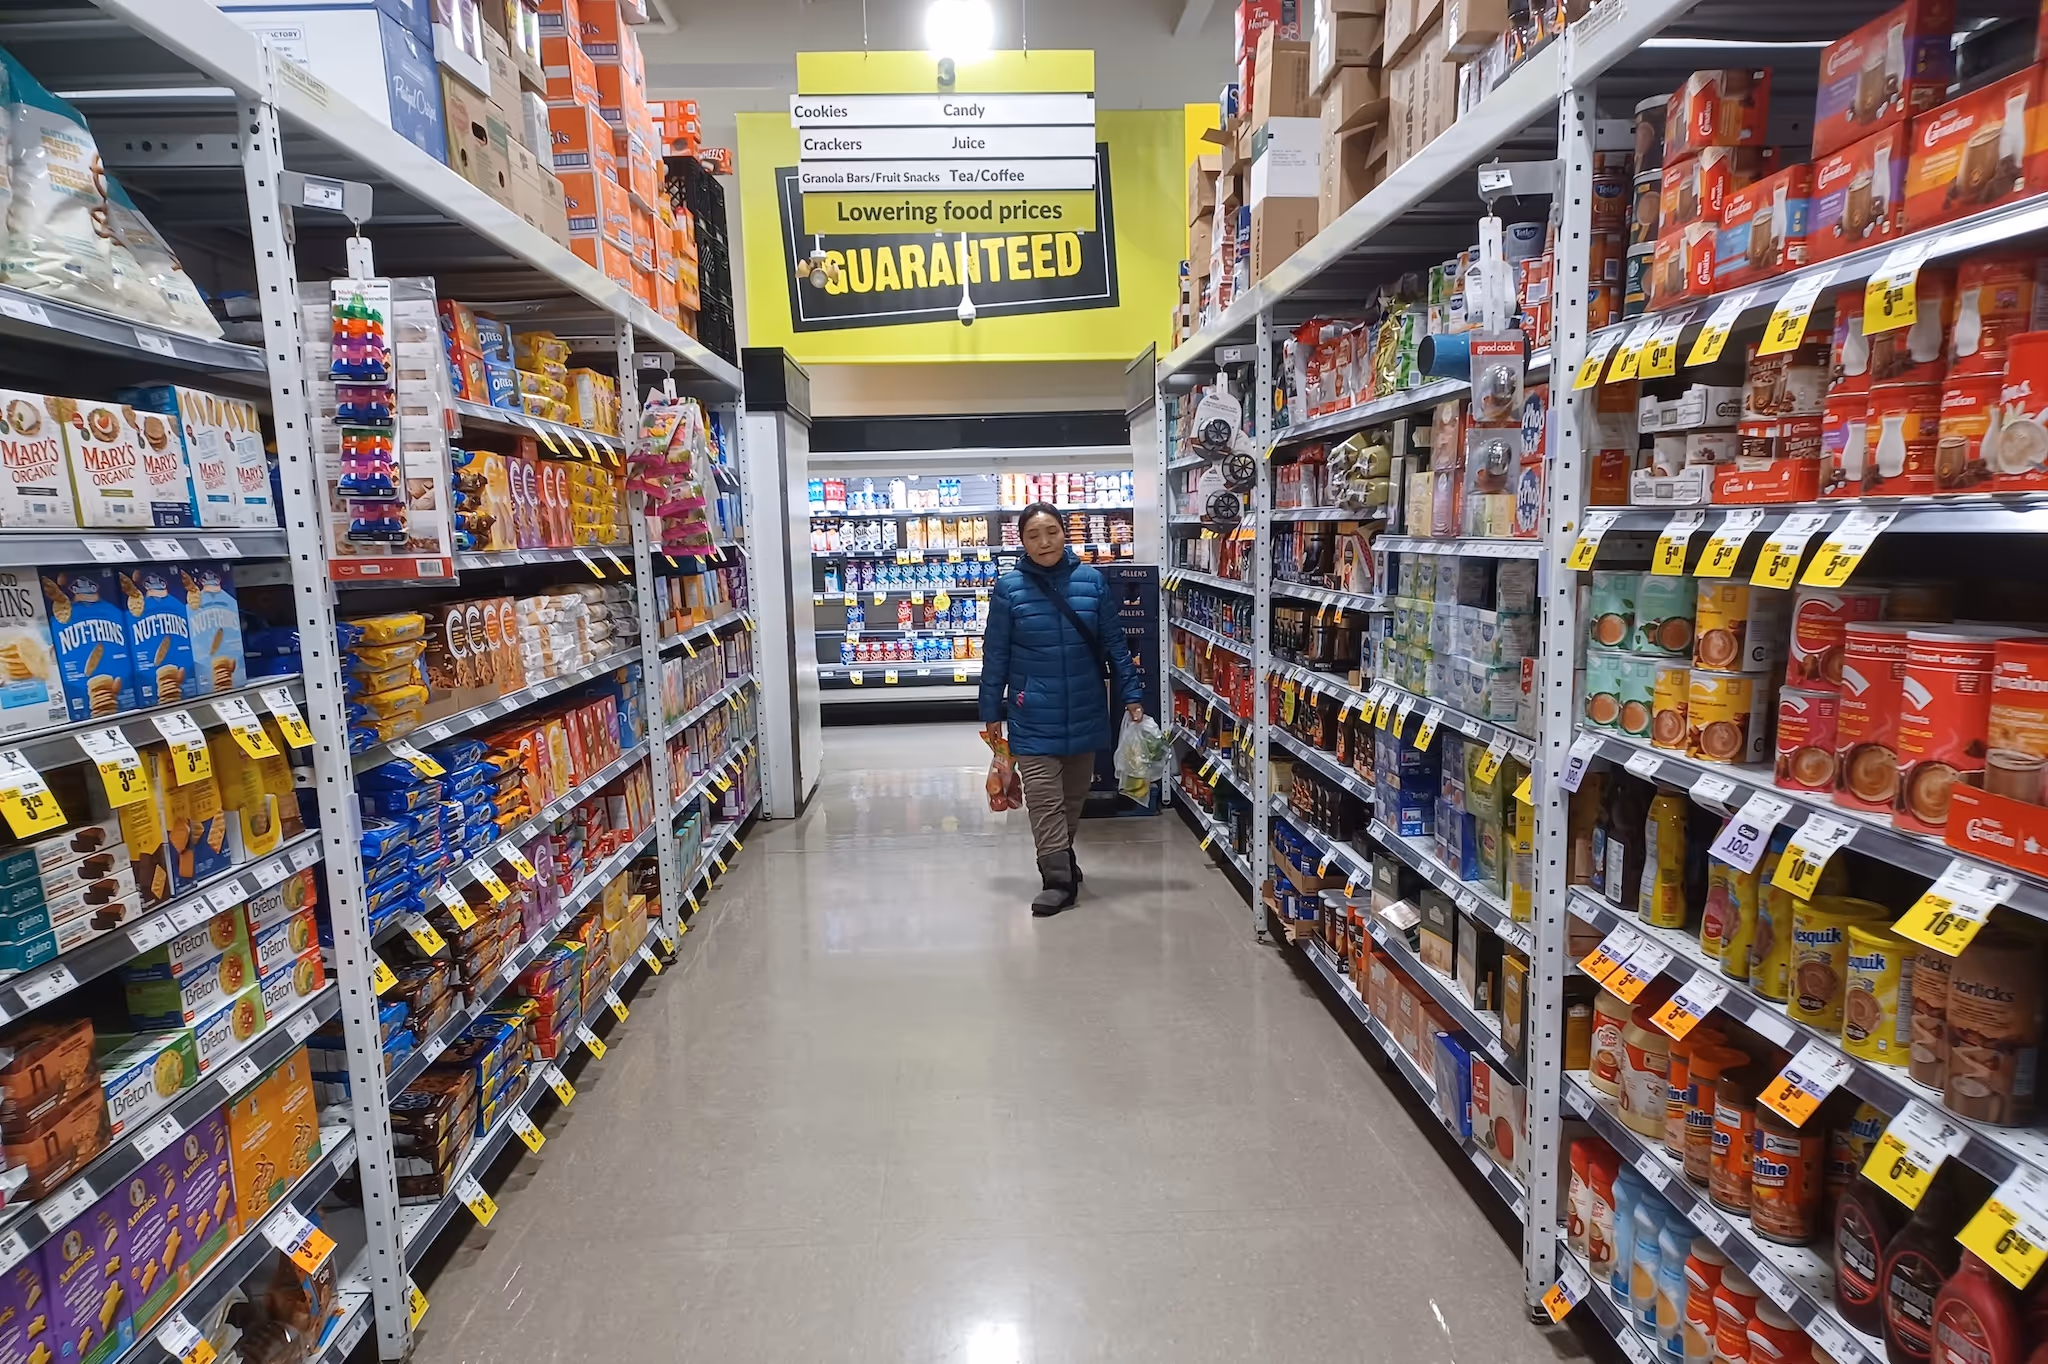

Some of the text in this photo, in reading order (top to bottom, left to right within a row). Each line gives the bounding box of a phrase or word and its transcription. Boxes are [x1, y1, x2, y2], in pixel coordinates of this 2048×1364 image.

[1252, 7, 1269, 19] Tim
[579, 20, 601, 35] ifs
[1827, 45, 1864, 76] Carnation
[793, 104, 848, 119] Cookies
[943, 103, 986, 119] Candy
[1700, 100, 1714, 136] Carnation
[550, 129, 571, 145] ifs
[1923, 114, 1975, 148] Carnation
[803, 137, 863, 151] Crackers
[951, 136, 986, 150] Juice
[802, 171, 940, 185] Granola Bars/Fruit Snacks
[949, 168, 1025, 183] Tea/Coffee
[1817, 160, 1852, 190] Carnation
[837, 199, 1063, 225] Lowering food prices
[1725, 199, 1754, 224] Carnation
[1516, 226, 1538, 238] Tetley
[821, 231, 1084, 296] GUARANTEED
[1698, 250, 1711, 286] Carnation
[479, 331, 503, 345] OREO
[492, 378, 514, 391] OREO
[0, 436, 60, 467] MARY'S
[81, 442, 137, 470] MARY'S
[12, 463, 58, 484] ORGANIC
[142, 451, 179, 475] MARY'S
[198, 459, 226, 480] MARY'S
[236, 464, 264, 482] MARY'S
[92, 467, 136, 487] ORGANIC
[149, 471, 178, 487] ORGANIC
[1121, 569, 1148, 578] ALLEN'S
[897, 607, 912, 618] Silk
[58, 618, 126, 655] NUT-THINS
[856, 651, 870, 661] Silk
[870, 651, 884, 661] Silk
[884, 650, 899, 660] Silk
[899, 650, 914, 661] Silk
[1965, 818, 2016, 849] Carnation
[1726, 836, 1749, 855] 100
[252, 893, 282, 919] Breton
[17, 913, 45, 936] glutino
[25, 939, 52, 964] glutino
[171, 929, 210, 960] Breton
[260, 936, 289, 962] Breton
[184, 976, 219, 1007] Breton
[264, 980, 294, 1008] Breton
[200, 1023, 232, 1056] Breton
[113, 1079, 154, 1117] Breton
[1667, 1085, 1689, 1101] ine
[1713, 1131, 1731, 1146] ne
[1850, 1118, 1881, 1139] quik
